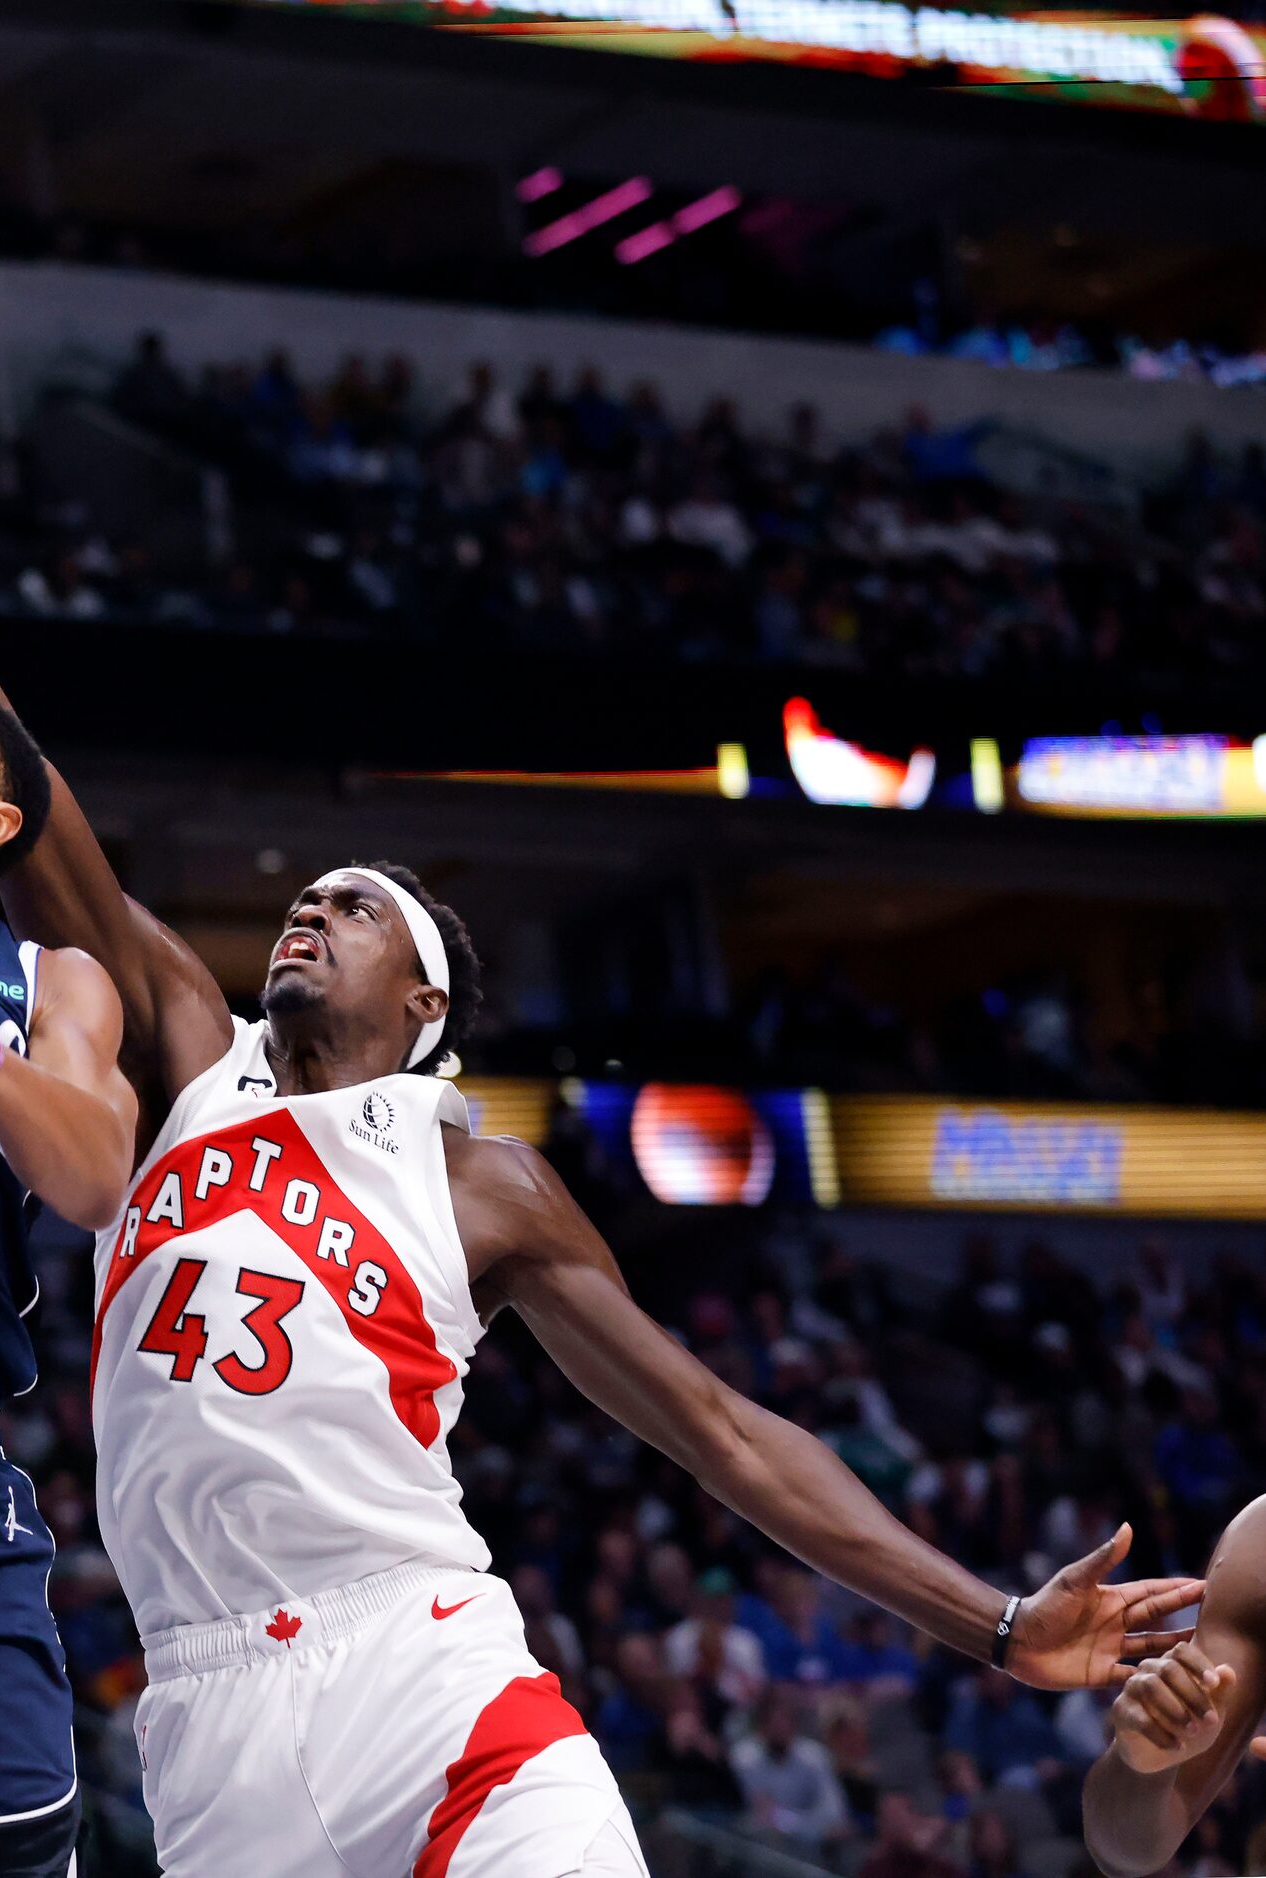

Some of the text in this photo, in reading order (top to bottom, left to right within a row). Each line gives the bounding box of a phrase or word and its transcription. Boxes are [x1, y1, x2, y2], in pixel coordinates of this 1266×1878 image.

[348, 1119, 400, 1155] Sun Life
[119, 1136, 389, 1317] RAPTORS
[136, 1257, 306, 1396] 43
